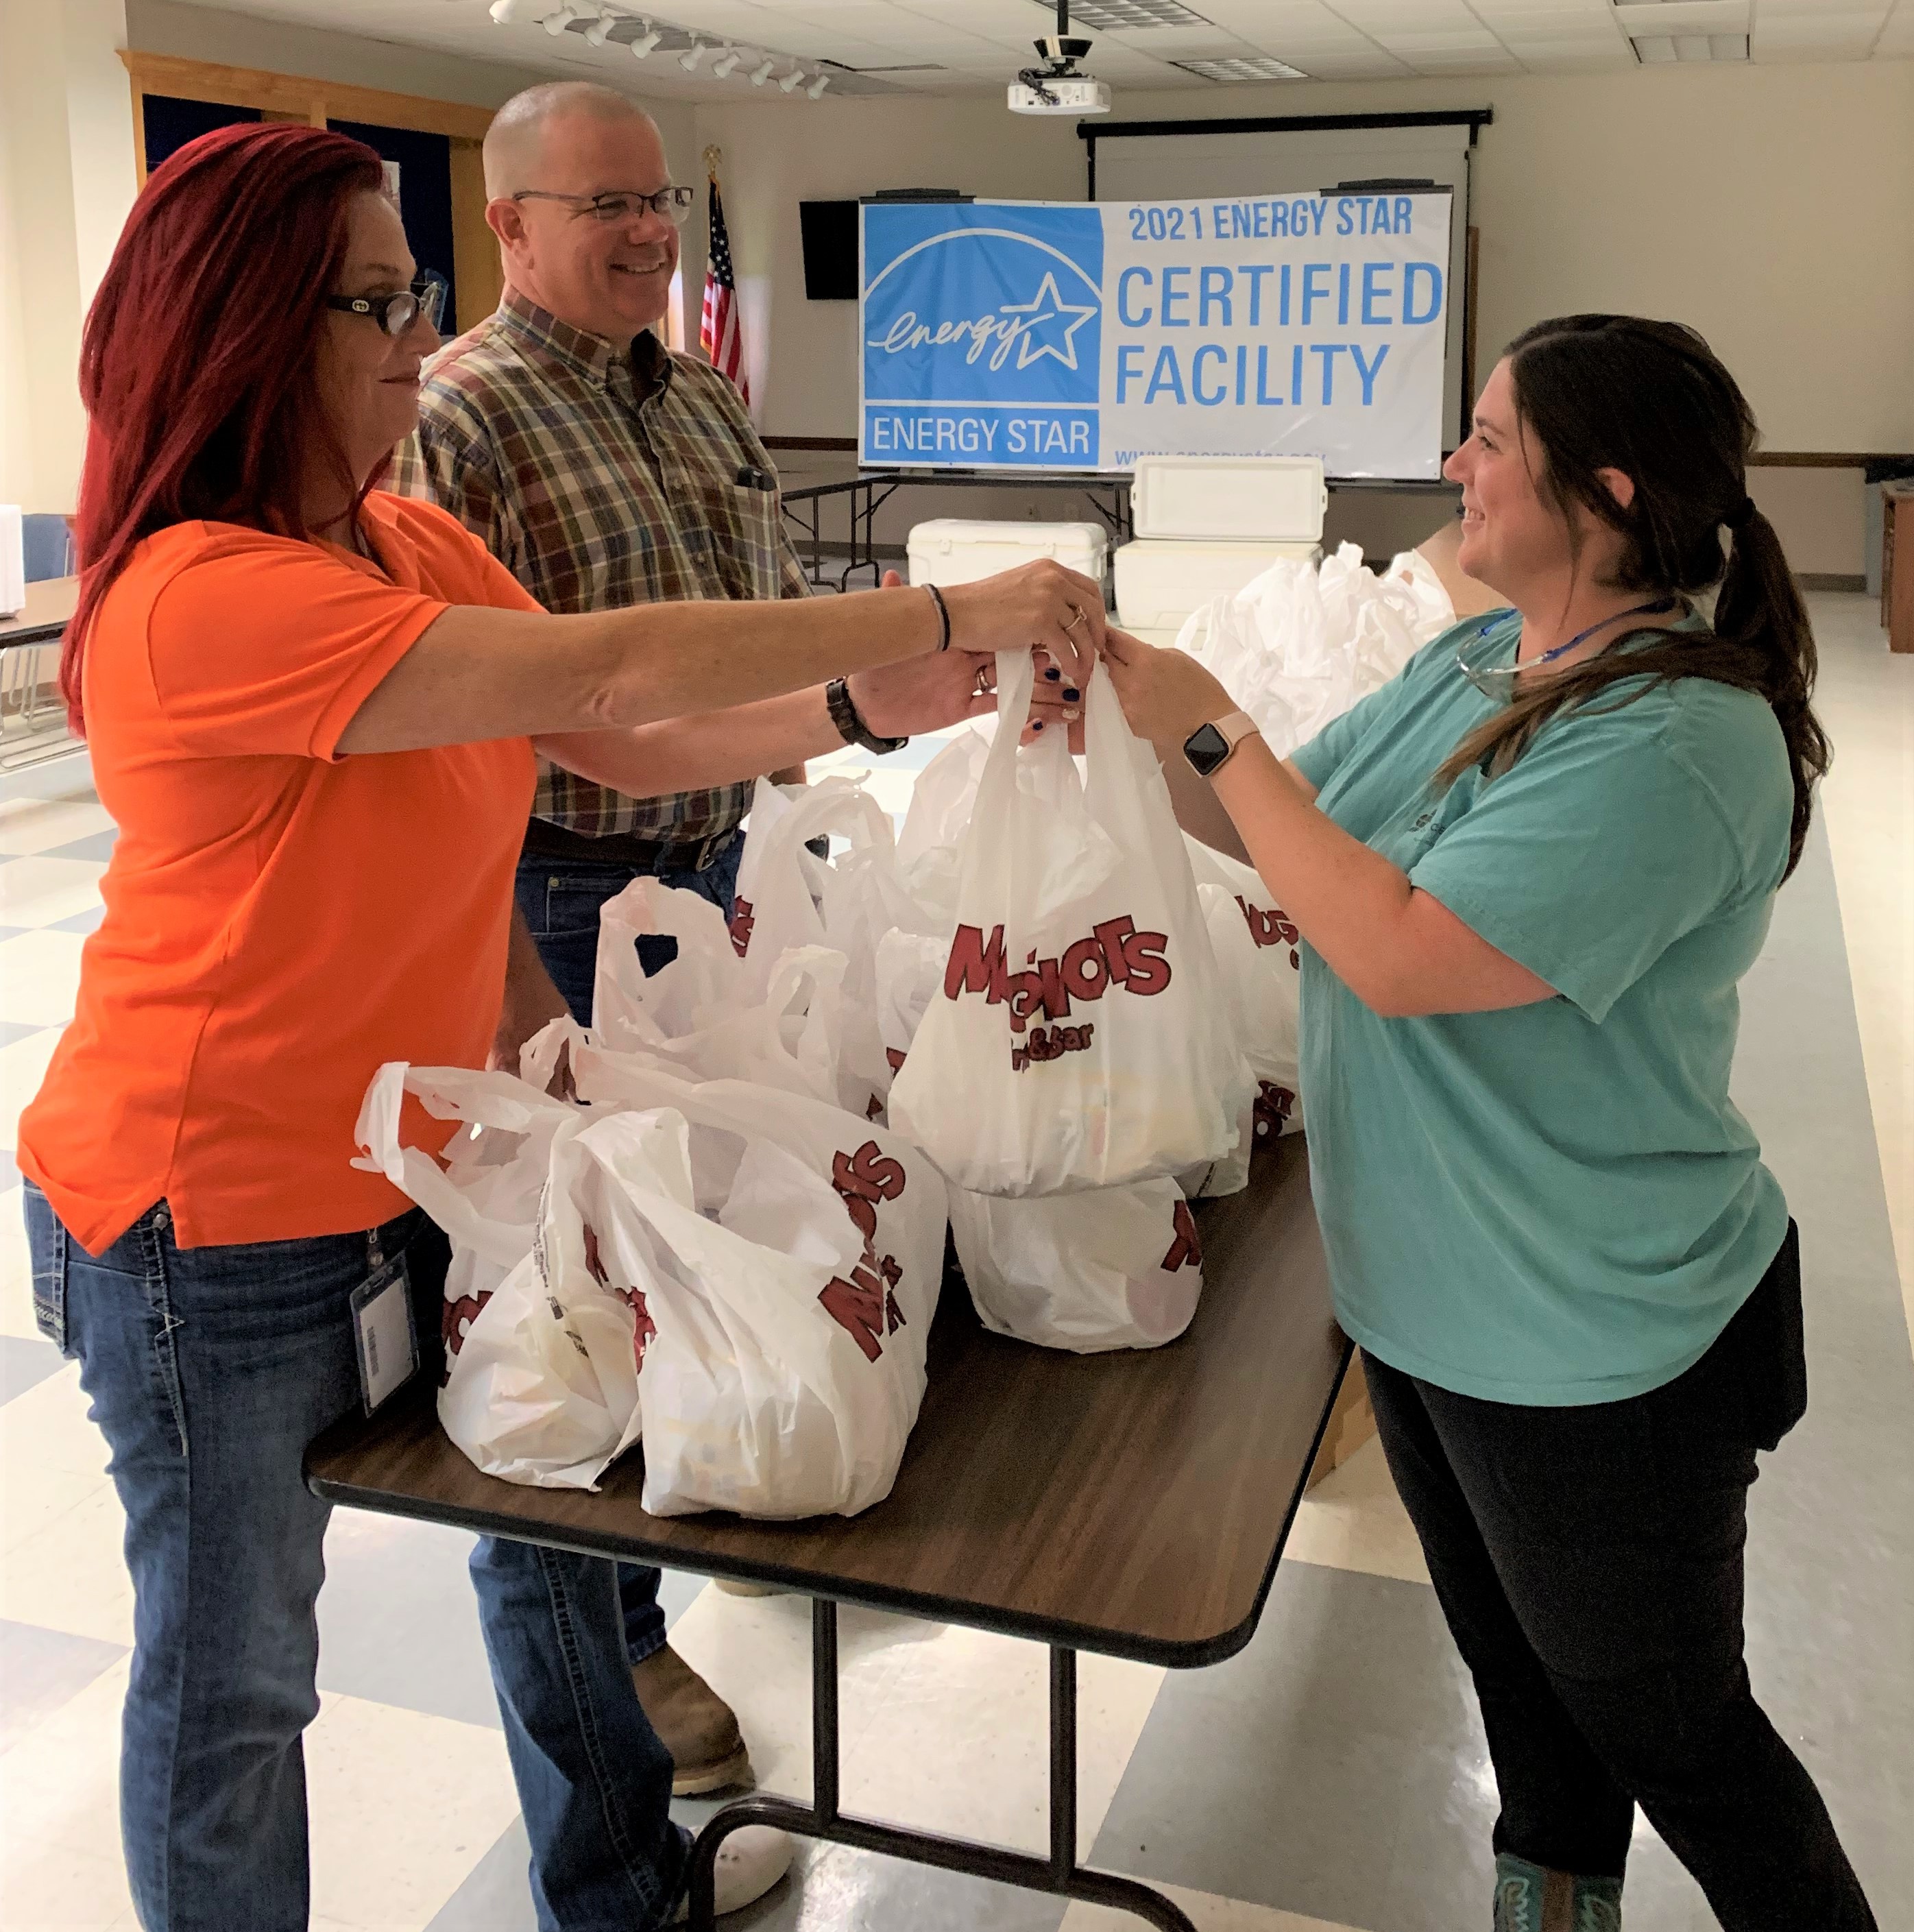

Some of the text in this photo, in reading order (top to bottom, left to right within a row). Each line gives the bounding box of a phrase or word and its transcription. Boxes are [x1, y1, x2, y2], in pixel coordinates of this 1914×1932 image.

[1128, 197, 1412, 241] 2021 ENERGY STAR
[1117, 263, 1443, 328] CERTIFIED
[867, 311, 1054, 372] energy
[1115, 344, 1391, 407] FACILITY
[873, 417, 1089, 454] ENERGY STAR
